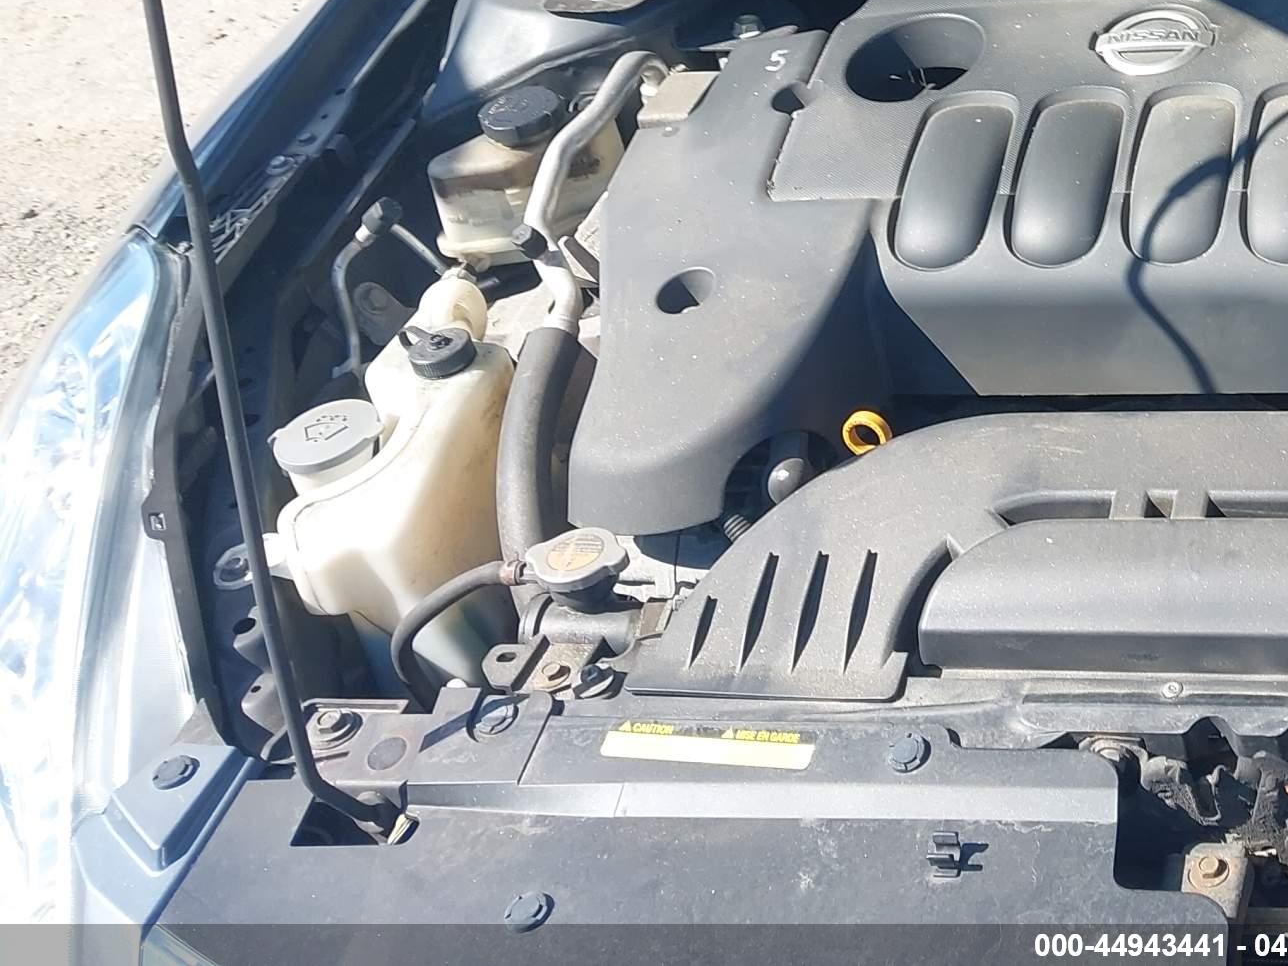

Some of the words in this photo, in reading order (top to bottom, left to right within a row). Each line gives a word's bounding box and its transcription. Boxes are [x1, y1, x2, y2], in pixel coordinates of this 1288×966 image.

[1108, 29, 1200, 43] NISSAN
[764, 49, 789, 71] 5
[632, 722, 673, 735] CAUTION
[735, 729, 757, 741] MISE
[756, 730, 770, 742] EN
[769, 731, 800, 745] GARDE
